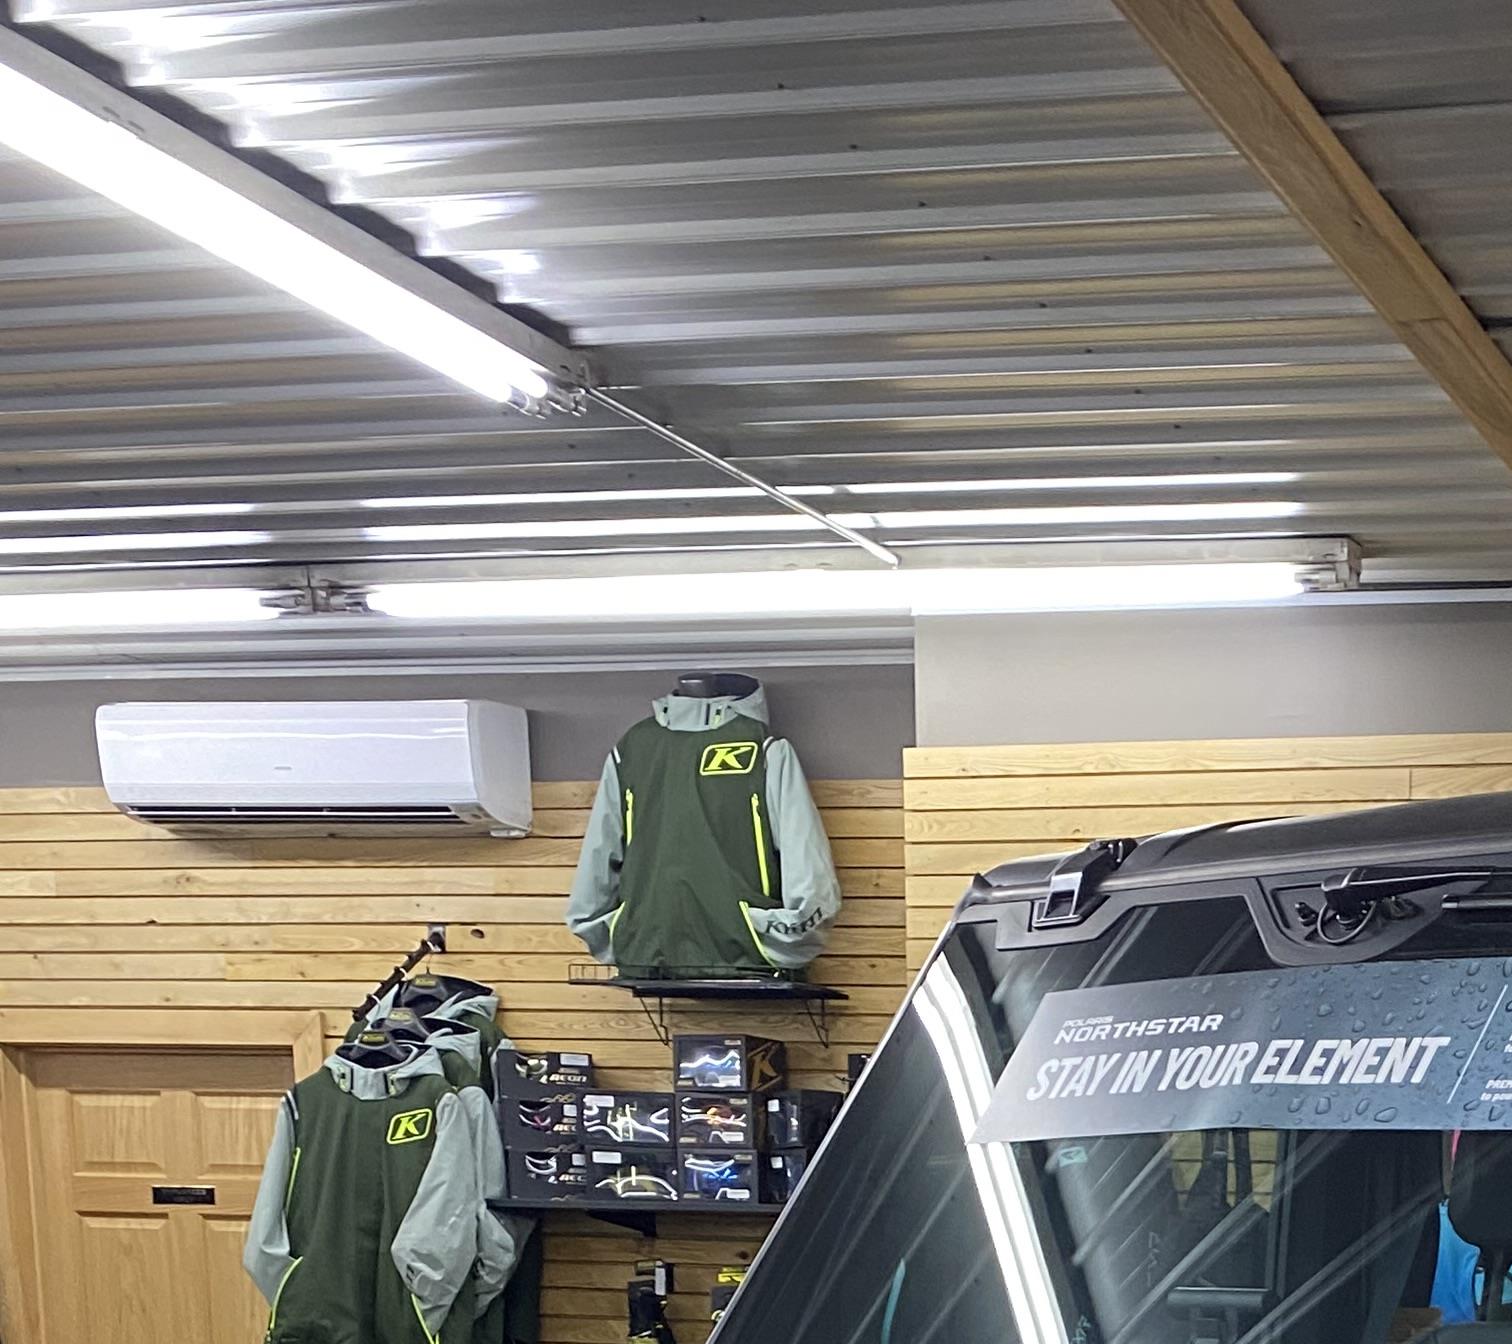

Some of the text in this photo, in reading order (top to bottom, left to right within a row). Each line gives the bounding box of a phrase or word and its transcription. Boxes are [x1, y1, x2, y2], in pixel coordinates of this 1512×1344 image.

[1053, 1014, 1225, 1045] NORTHSTAR
[1063, 1016, 1114, 1028] POLARIS
[1026, 1036, 1452, 1101] STAY IN YOUR ELEMENT
[1480, 1092, 1492, 1101] to
